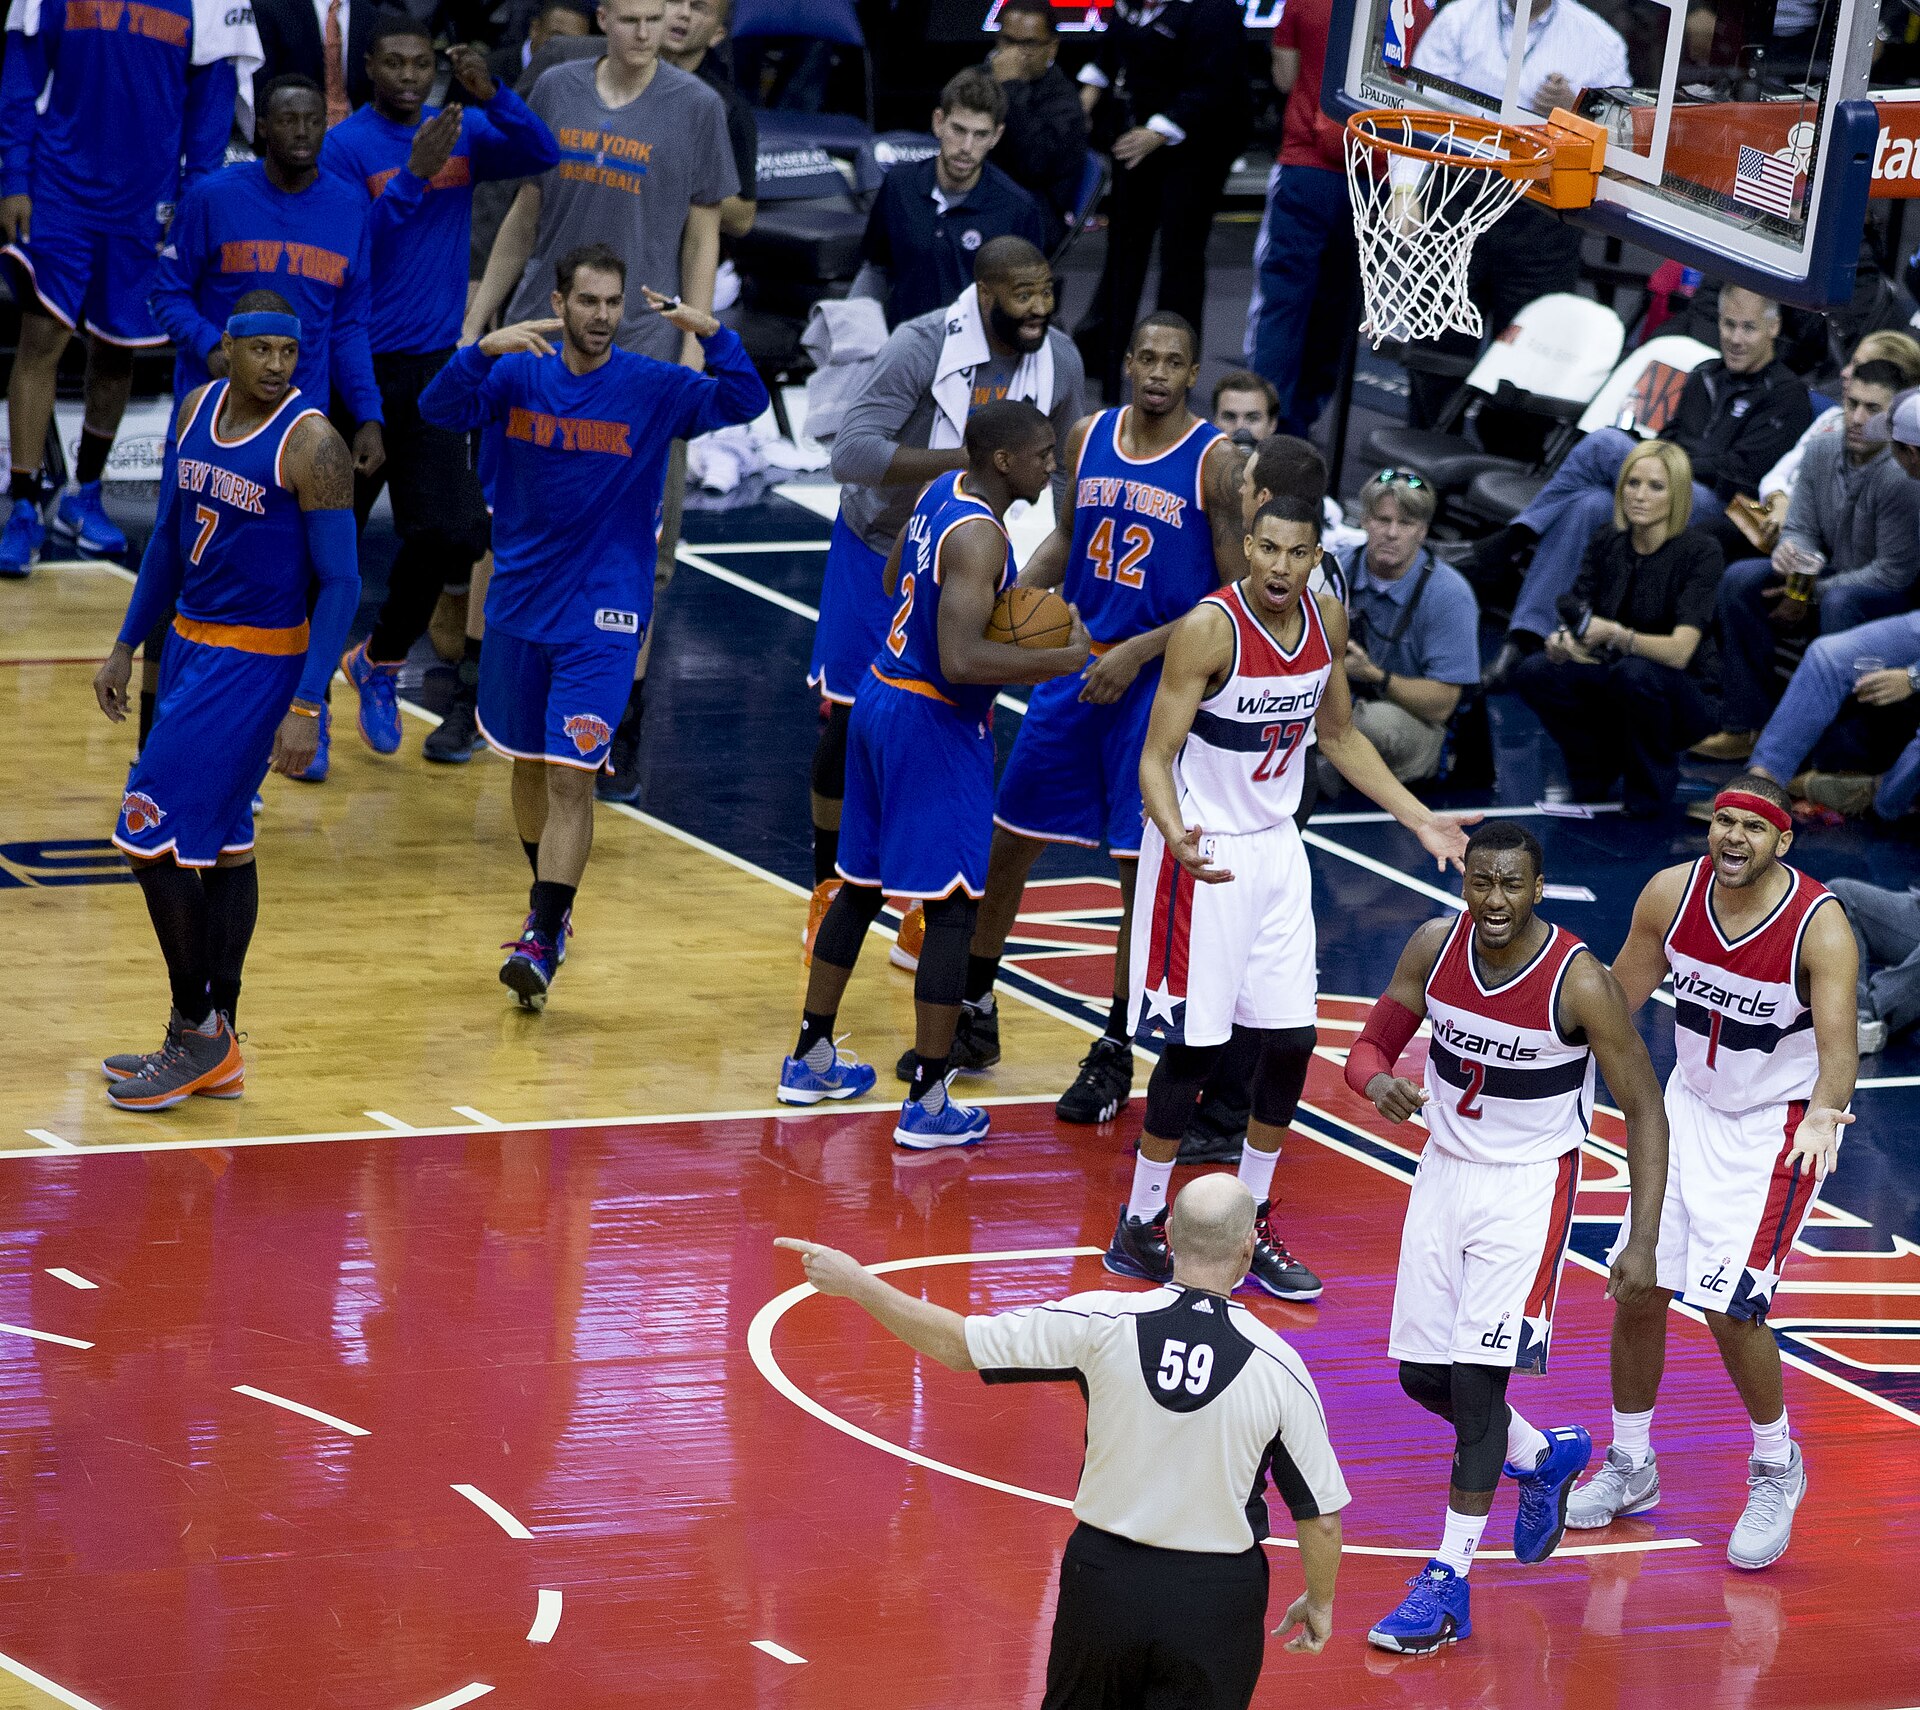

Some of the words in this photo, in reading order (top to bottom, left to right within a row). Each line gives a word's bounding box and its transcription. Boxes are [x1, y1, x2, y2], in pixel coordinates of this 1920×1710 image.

[1384, 42, 1401, 61] NBA
[1358, 82, 1405, 110] SPALDING
[559, 127, 599, 149] NEW
[602, 132, 653, 164] YORK
[220, 239, 284, 273] NEW
[284, 242, 349, 288] YORK
[505, 406, 557, 448] NEW
[557, 417, 633, 458] YORK
[210, 465, 267, 515] YORK
[1076, 477, 1124, 509] NEW
[1123, 480, 1188, 529] YORK
[189, 502, 220, 566] 7
[1086, 516, 1154, 590] 42
[886, 571, 916, 659] 2
[1251, 721, 1306, 782] 22
[1706, 1008, 1723, 1073] 1
[1456, 1057, 1486, 1121] 2
[1699, 1264, 1728, 1293] dc
[1480, 1320, 1512, 1350] dc
[1157, 1338, 1215, 1395] 59
